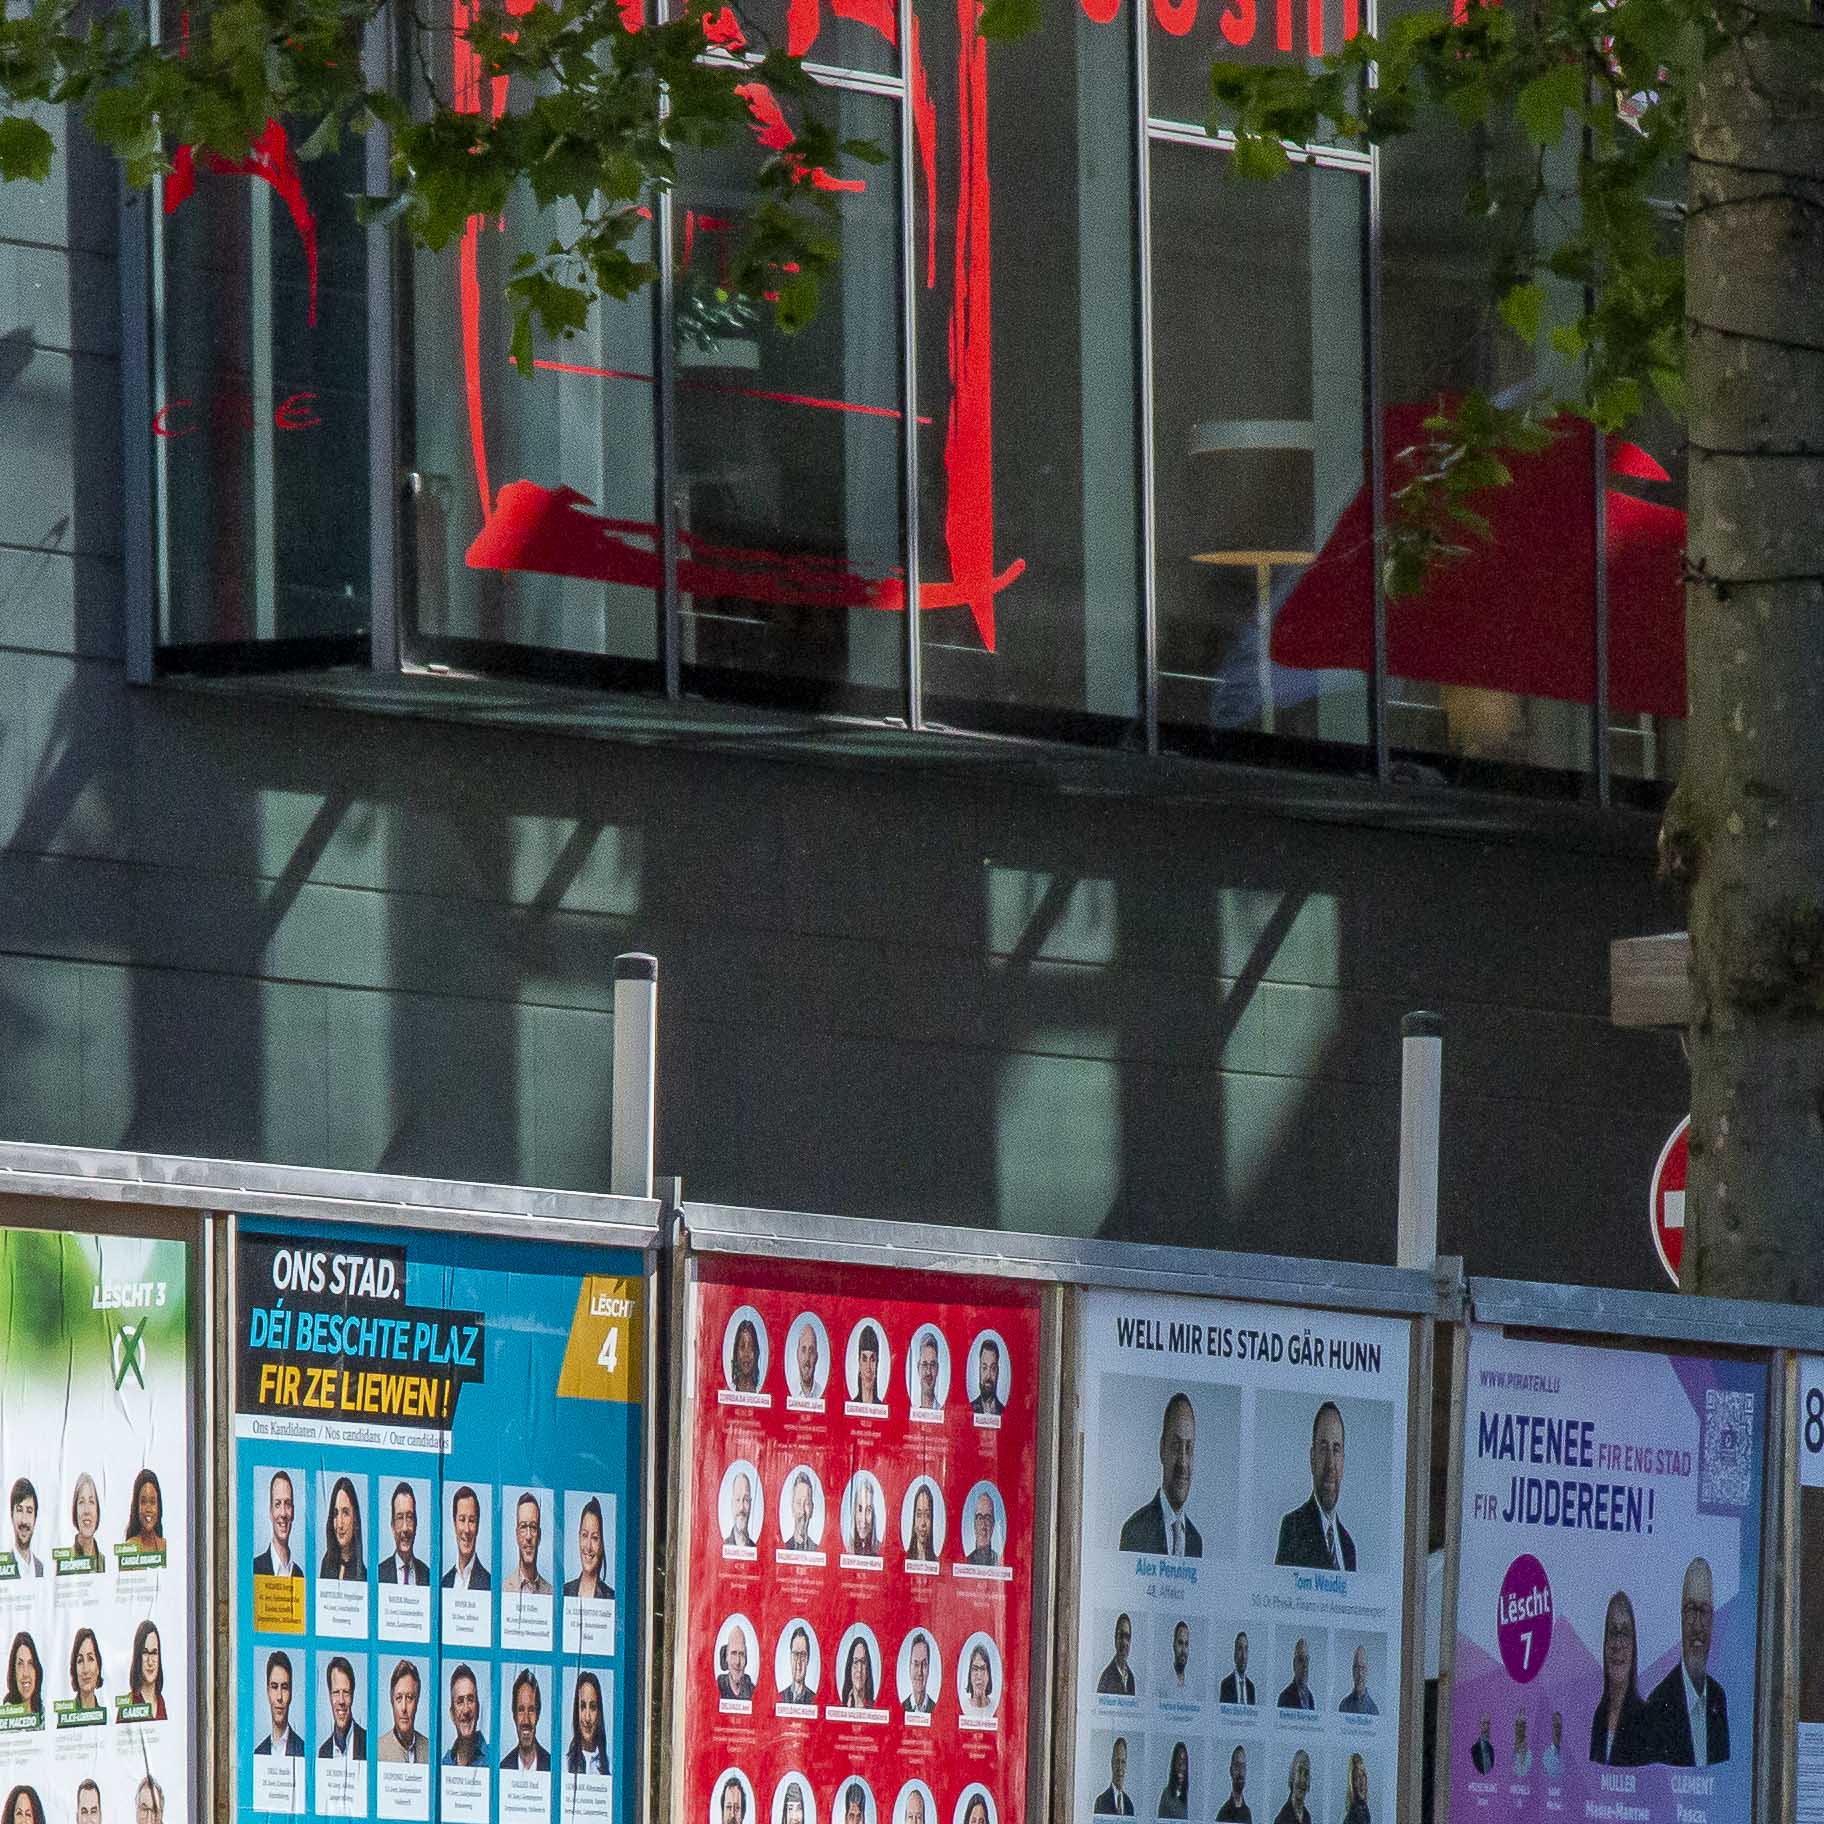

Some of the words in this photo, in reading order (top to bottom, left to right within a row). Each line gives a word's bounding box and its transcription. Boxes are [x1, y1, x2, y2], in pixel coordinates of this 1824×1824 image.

[92, 1279, 154, 1311] LËSCHT
[154, 1281, 167, 1307] 3
[273, 1248, 325, 1292] ONS
[328, 1254, 401, 1301] STAD.
[249, 1299, 292, 1350] DÉI
[296, 1312, 409, 1361] BESCHTE
[412, 1324, 478, 1367] PLAZ
[597, 1326, 618, 1373] 4
[1116, 1317, 1165, 1352] WELL
[1168, 1322, 1202, 1355] MIR
[1207, 1326, 1233, 1359] EIS
[1236, 1329, 1283, 1363] STAD
[1287, 1328, 1325, 1368] GÄR
[1328, 1339, 1382, 1374] HUNN
[258, 1364, 300, 1407] FIR
[303, 1367, 336, 1409] ZE
[340, 1370, 439, 1418] LIEWEN
[1479, 1369, 1561, 1394] WWW.PIRATEN.LU
[252, 1420, 269, 1434] Ons
[270, 1422, 317, 1440] Kandidaten
[325, 1426, 341, 1441] Nos
[341, 1428, 381, 1445] candidats
[389, 1431, 405, 1445] Our
[1804, 1387, 1824, 1453] 8
[1478, 1410, 1595, 1469] MATENEE
[1598, 1442, 1623, 1468] FIR
[1625, 1446, 1657, 1473] ENG
[1658, 1449, 1693, 1477] STAD
[1474, 1494, 1498, 1520] FIR
[1135, 1557, 1157, 1577] Alex
[1499, 1587, 1551, 1626] Lëscht
[1520, 1631, 1532, 1671] 7
